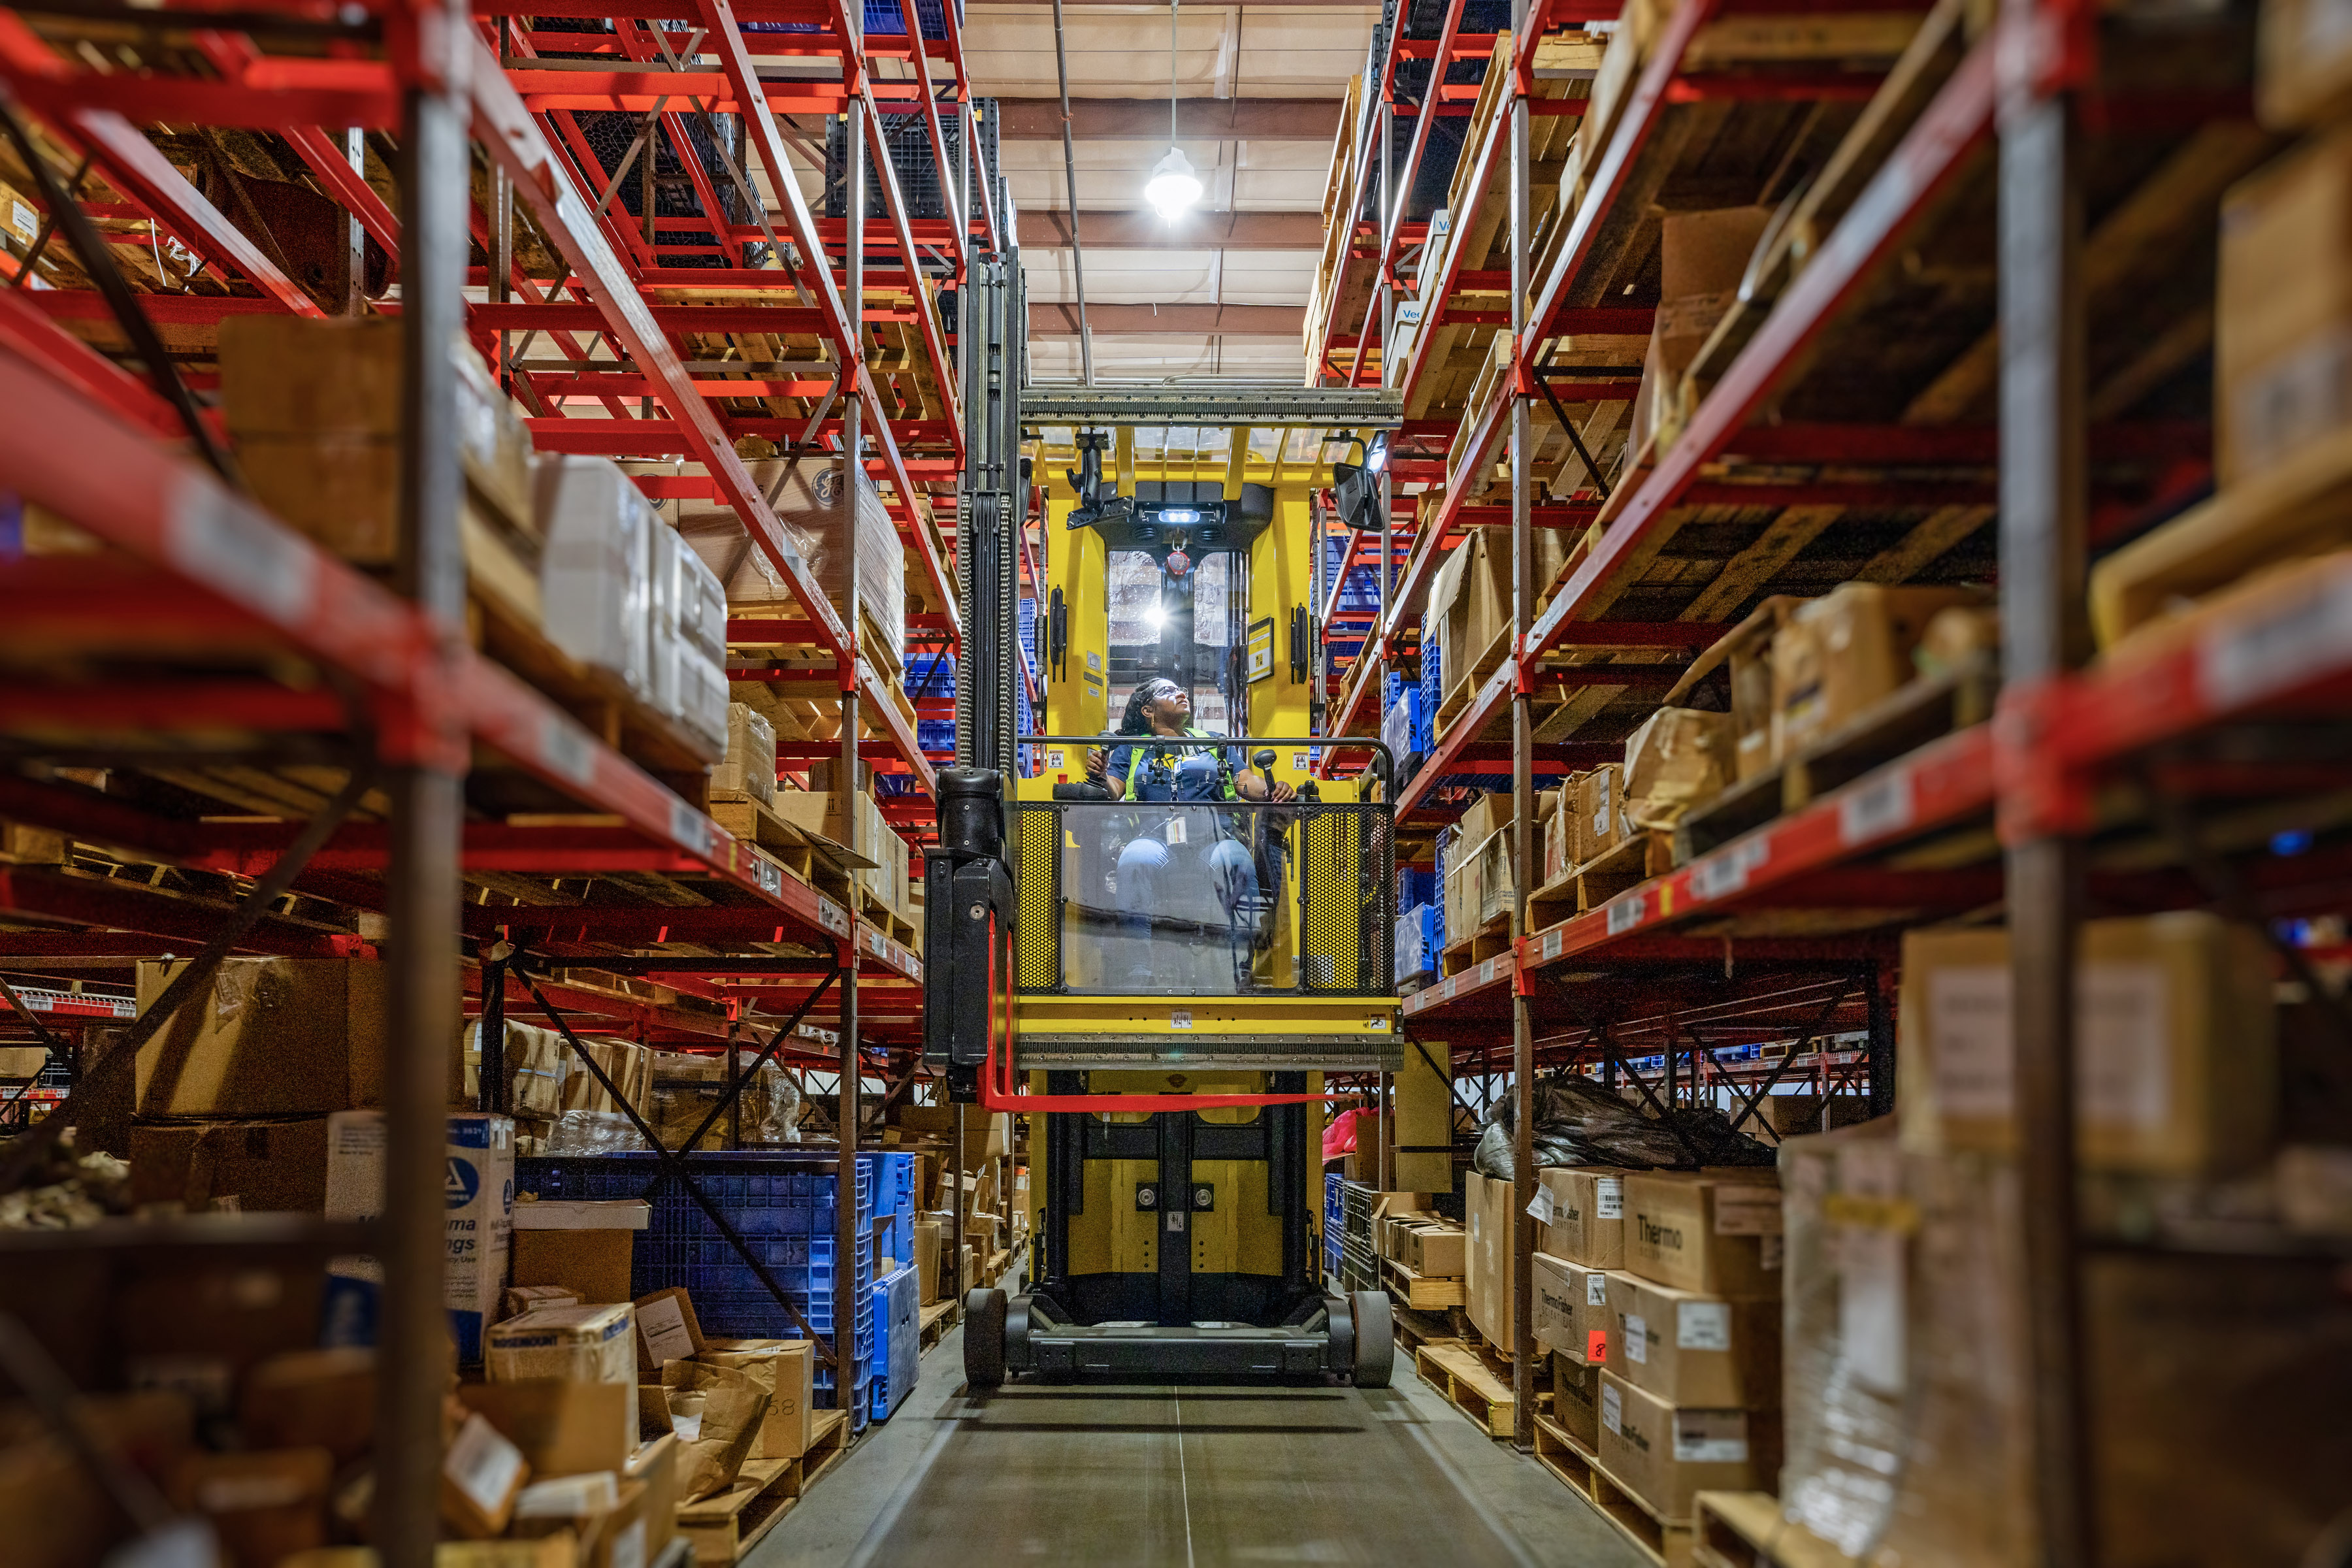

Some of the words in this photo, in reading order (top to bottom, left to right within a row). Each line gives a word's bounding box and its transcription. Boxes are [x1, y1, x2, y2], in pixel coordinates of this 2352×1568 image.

[1637, 1213, 1683, 1252] Thermo
[1541, 1288, 1573, 1316] ThermoFisher
[1595, 1343, 1605, 1357] 8
